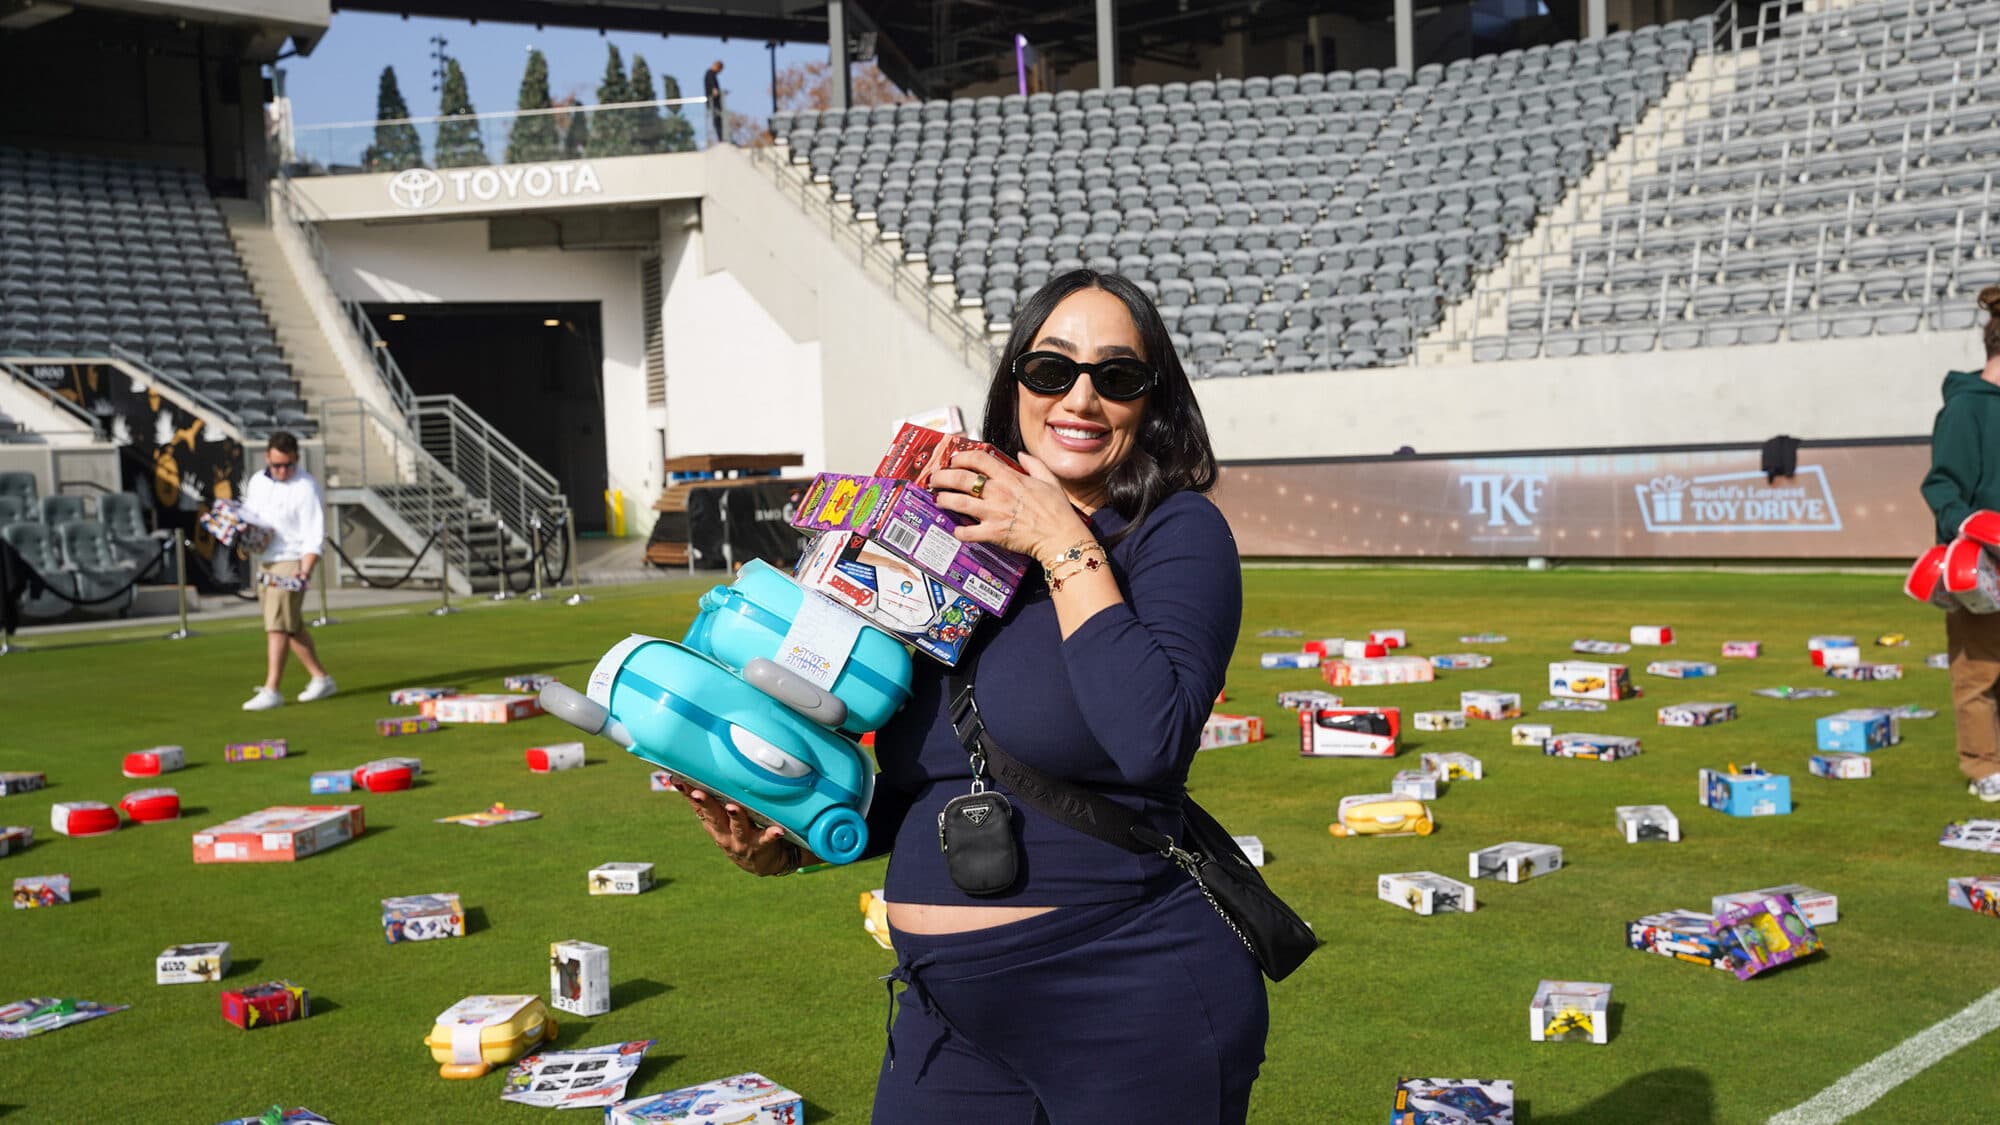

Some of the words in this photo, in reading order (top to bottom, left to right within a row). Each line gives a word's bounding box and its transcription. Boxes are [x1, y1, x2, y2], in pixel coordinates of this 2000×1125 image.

[449, 164, 601, 200] TOYOTA
[1459, 475, 1547, 526] TKF
[1691, 487, 1744, 499] World's
[1748, 486, 1805, 499] Largest
[1692, 501, 1740, 521] TOY
[1744, 500, 1825, 521] DRIVE
[784, 652, 828, 682] IMAGINE
[798, 646, 826, 668] ZONE
